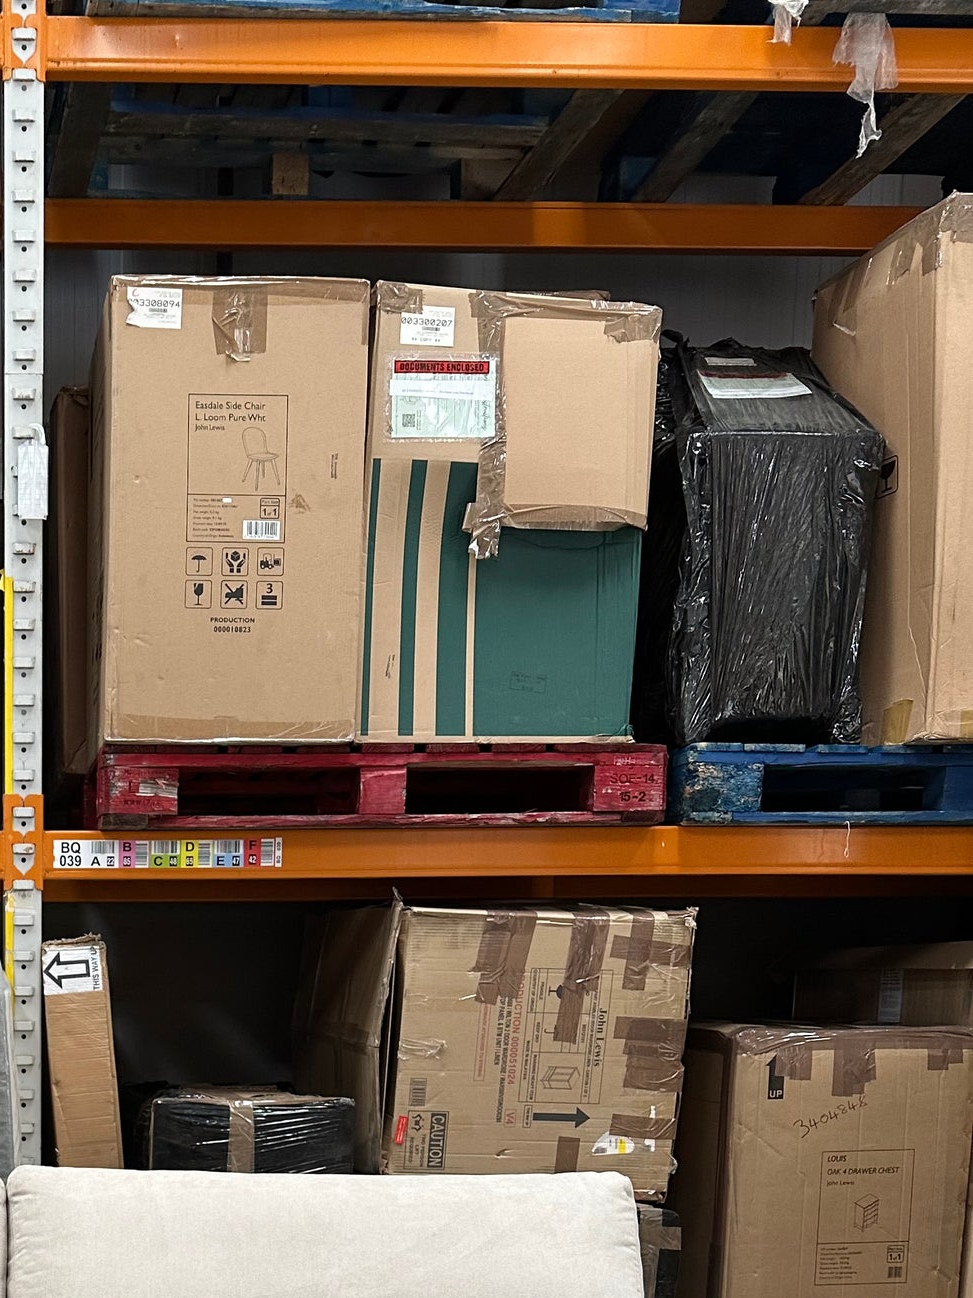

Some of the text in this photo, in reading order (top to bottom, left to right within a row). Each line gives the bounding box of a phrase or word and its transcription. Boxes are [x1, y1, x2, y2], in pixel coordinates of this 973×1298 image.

[129, 298, 180, 308] 03308094
[401, 317, 453, 327] 003300207
[399, 362, 484, 372] DOCUMENTS ENCLOSED
[195, 400, 266, 410] Easdale Side Chair
[203, 413, 227, 422] Loom
[228, 413, 247, 422] Pure
[248, 414, 266, 422] Wht
[194, 424, 209, 432] John
[266, 583, 274, 594] 3
[61, 841, 81, 854] BQ
[122, 842, 132, 852] B
[185, 841, 195, 852] D
[249, 840, 257, 850] F
[59, 855, 82, 867] 039
[91, 856, 101, 866] A
[153, 856, 163, 866] C
[216, 856, 225, 866] E
[248, 855, 257, 864] 42
[89, 946, 100, 990] THIS WAY UP
[592, 1006, 608, 1068] John Lewis
[506, 1036, 521, 1085] 000051024
[769, 1089, 783, 1098] UP
[505, 1111, 515, 1125] V4
[428, 1115, 446, 1166] CAUTION
[827, 1155, 847, 1163] LOUIS
[827, 1168, 842, 1176] OAK
[847, 1167, 877, 1175] DRAWER
[877, 1166, 901, 1174] CHEST
